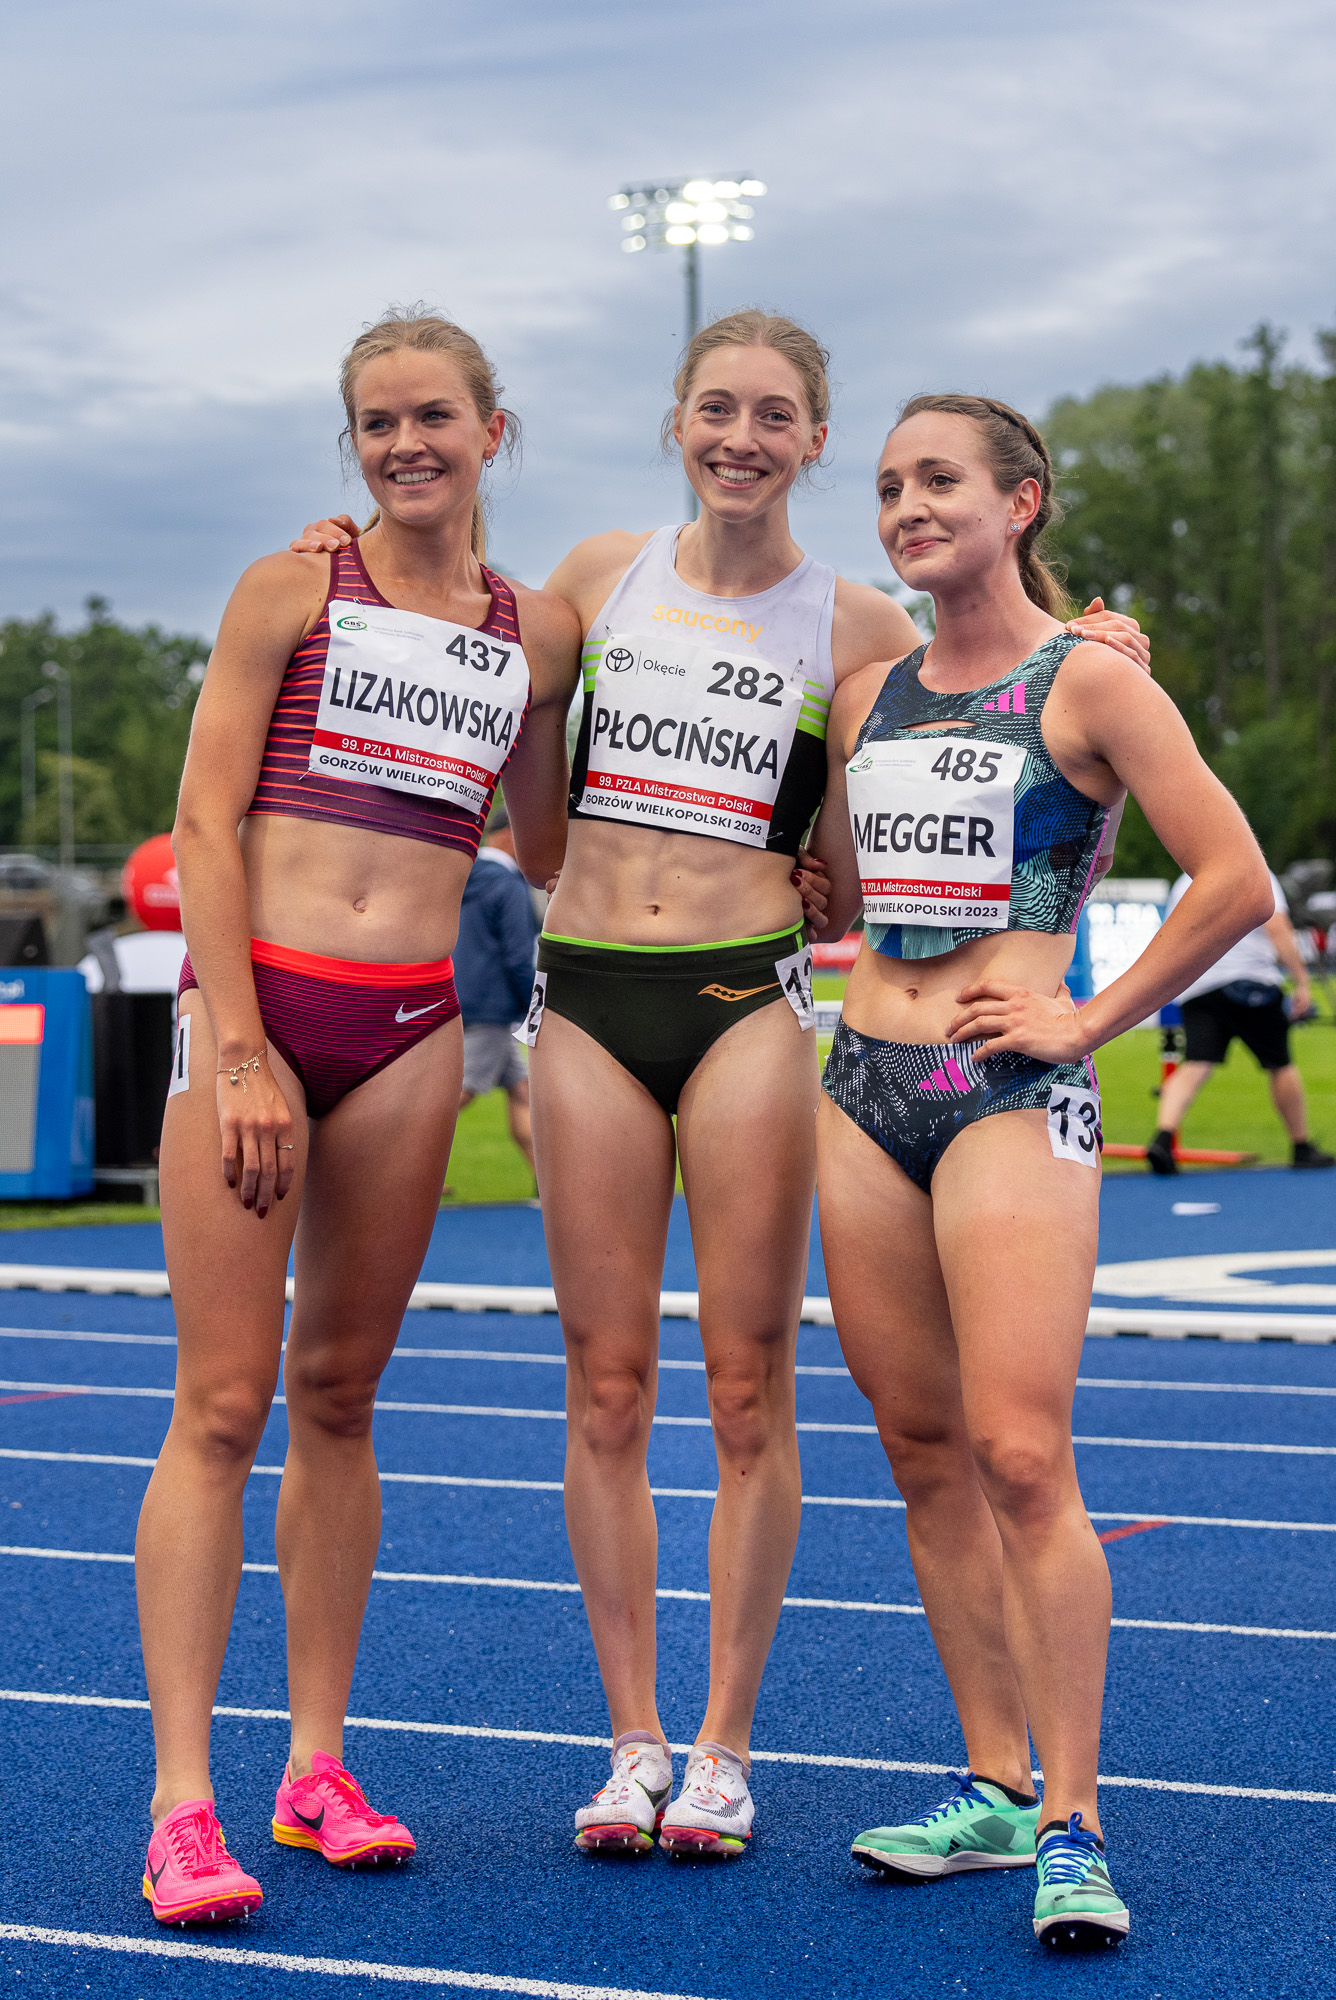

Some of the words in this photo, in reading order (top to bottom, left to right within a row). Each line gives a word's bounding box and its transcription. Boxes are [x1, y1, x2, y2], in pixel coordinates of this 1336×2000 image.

[651, 604, 764, 643] saucony
[445, 633, 511, 677] 437
[643, 658, 686, 677] Okęcie
[706, 661, 785, 707] 282
[329, 667, 514, 750] LIZAKOWSKA
[341, 737, 360, 751] 99.
[363, 742, 391, 758] PZLA
[394, 748, 464, 774] Mistrzostwa
[465, 766, 488, 783] Polski
[592, 707, 778, 779] PŁOCIŃSKA
[930, 747, 1003, 783] 485
[319, 754, 383, 776] GORZÓW
[386, 767, 472, 798] WIELKOPOLSKI
[599, 775, 613, 788] 99.
[615, 778, 641, 792] PZLA
[643, 783, 716, 805] Mistrzostwa
[717, 796, 753, 813] Polski
[585, 793, 633, 810] GORZÓW
[636, 801, 732, 828] WIELKOPOLSKI
[733, 820, 762, 836] 2023
[853, 812, 996, 858] MEGGER
[867, 882, 881, 893] PZLA
[882, 882, 942, 895] Mistrzostwa
[945, 885, 982, 898] Polski
[878, 902, 961, 917] WIELKOPOLSKI
[964, 906, 998, 918] 2023
[1050, 1096, 1097, 1152] 13
